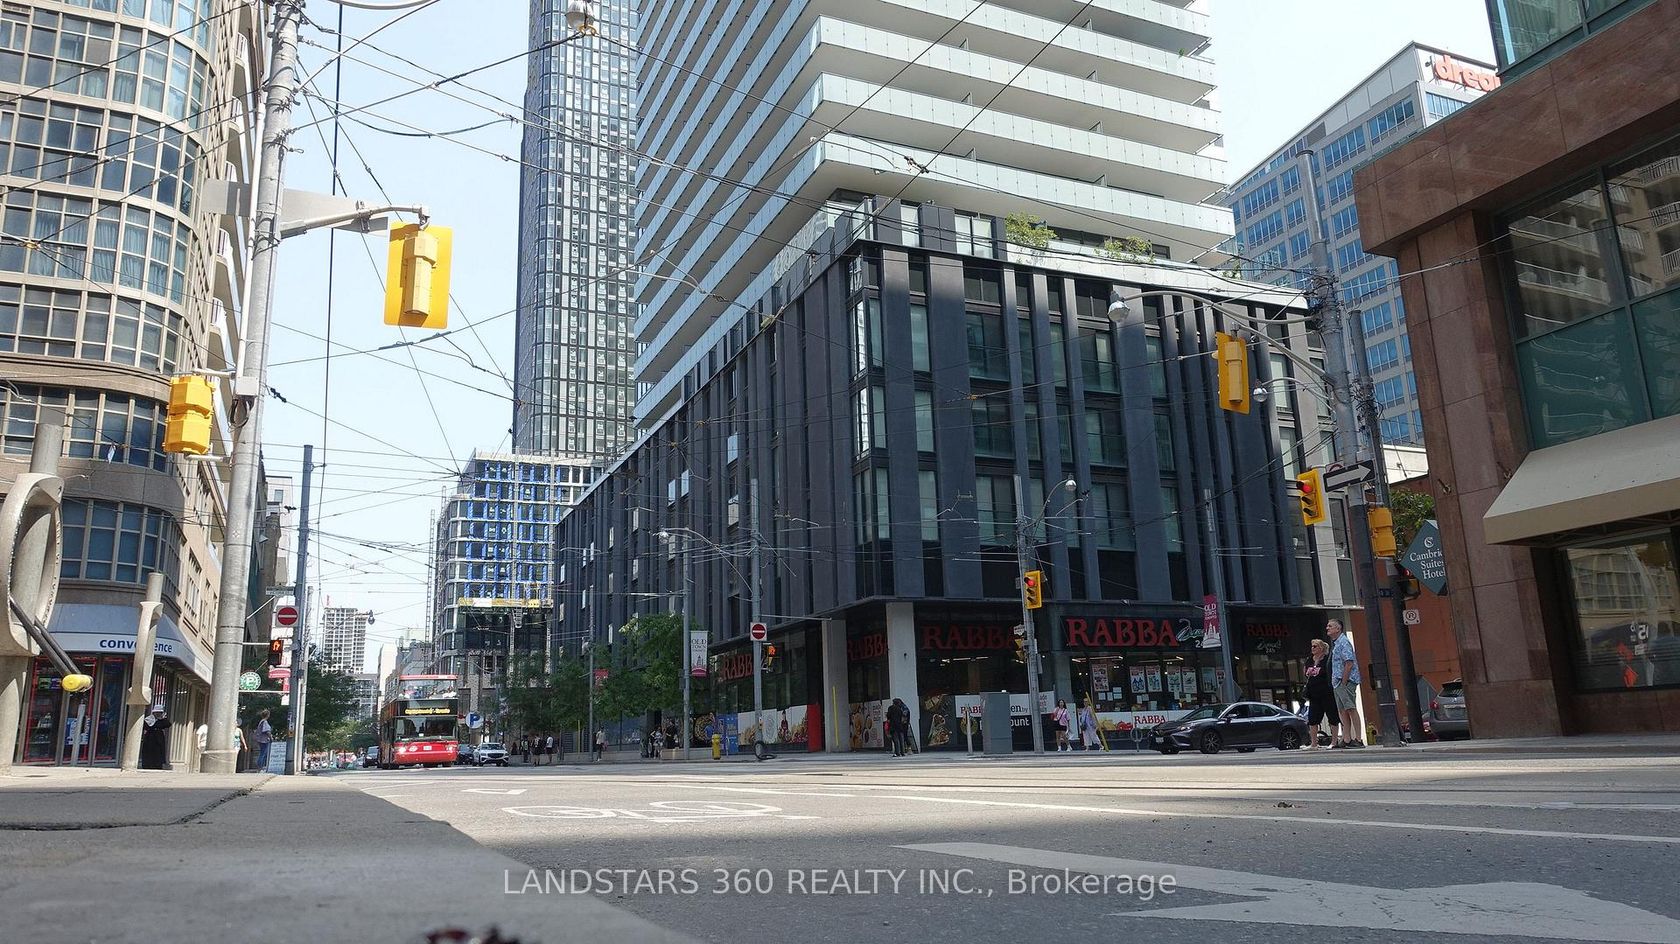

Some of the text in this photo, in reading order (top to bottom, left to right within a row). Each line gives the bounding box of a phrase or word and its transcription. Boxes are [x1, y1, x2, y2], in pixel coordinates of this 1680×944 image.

[1423, 567, 1446, 580] Hotel
[1066, 619, 1181, 647] RABBA
[1246, 624, 1292, 637] RABBA
[847, 633, 888, 661] RABB
[720, 654, 754, 681] RABB
[470, 714, 480, 727] P
[1134, 715, 1166, 724] RABBA
